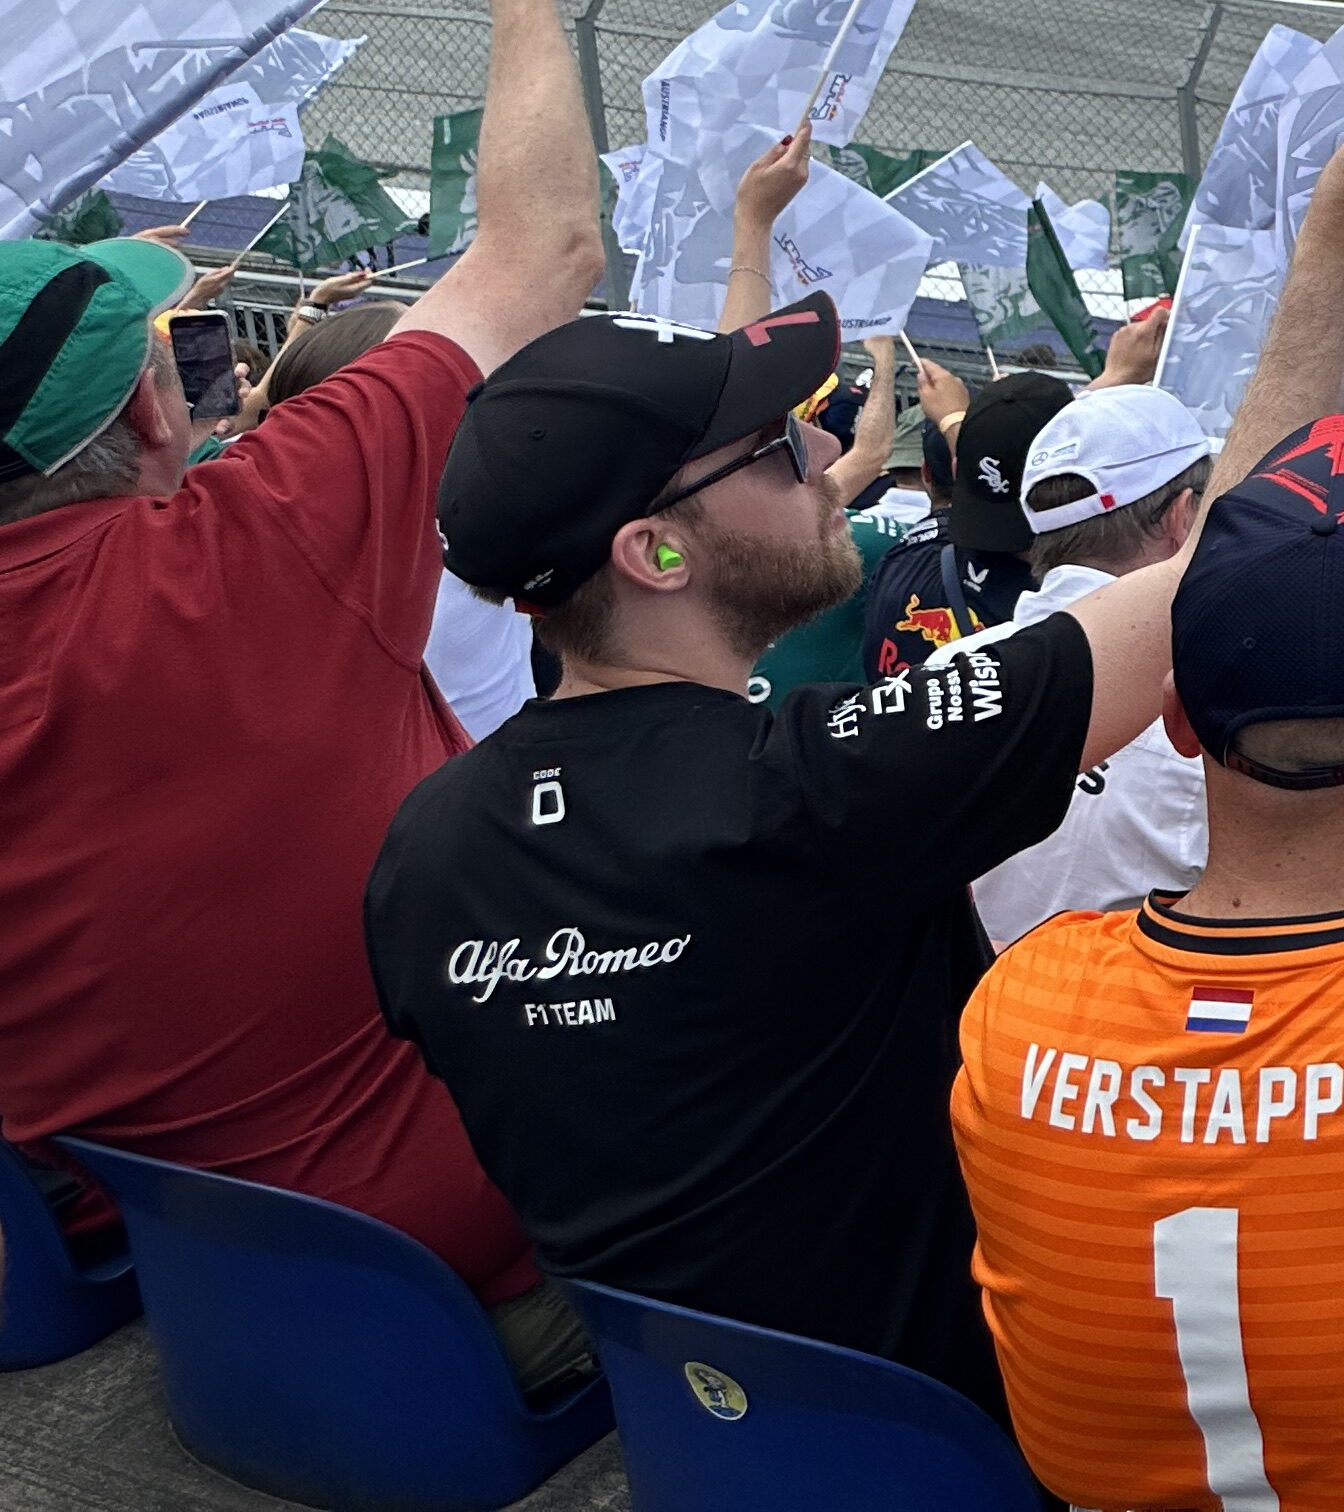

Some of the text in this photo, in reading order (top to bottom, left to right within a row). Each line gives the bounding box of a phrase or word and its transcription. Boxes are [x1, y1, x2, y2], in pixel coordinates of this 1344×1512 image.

[926, 678, 945, 730] Grupo
[533, 767, 562, 780] CODE
[448, 926, 692, 1003] Alfa Romeo
[525, 997, 616, 1026] F1 TEAM
[1154, 1207, 1280, 1512] 1
